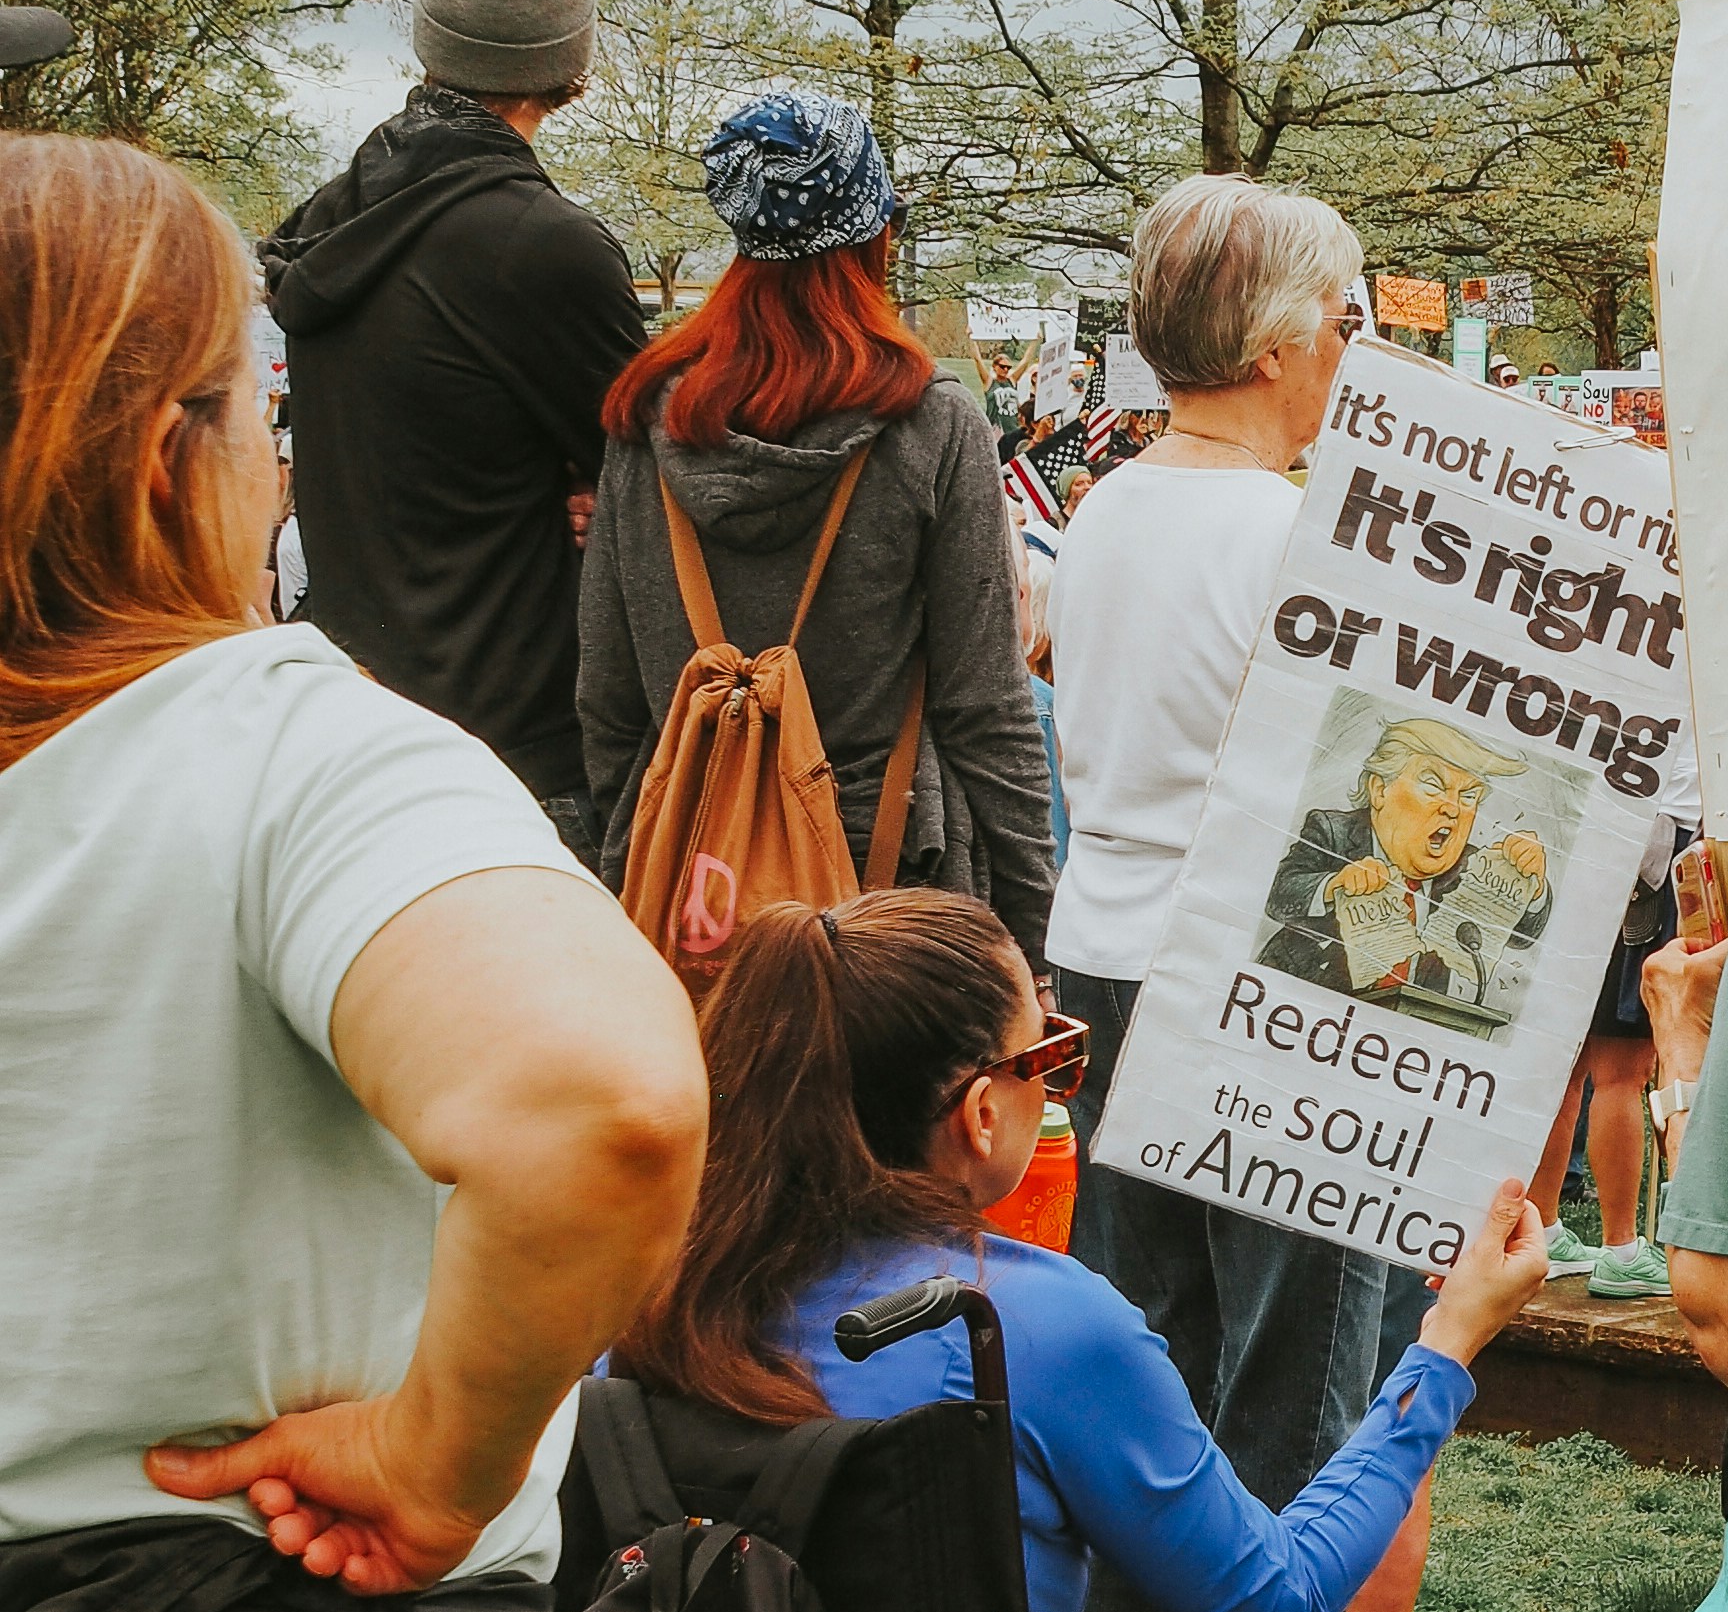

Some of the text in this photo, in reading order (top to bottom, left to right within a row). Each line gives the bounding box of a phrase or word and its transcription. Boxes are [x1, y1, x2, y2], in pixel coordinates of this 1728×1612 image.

[1330, 384, 1397, 448] It's
[1402, 421, 1492, 482] not
[1493, 447, 1577, 521] left
[1580, 495, 1636, 539] or
[1583, 378, 1609, 403] Say
[1584, 404, 1604, 417] NO
[1330, 466, 1684, 669] It's right
[1273, 593, 1680, 799] or wrong
[1470, 855, 1523, 901] People
[1218, 970, 1497, 1117] Redeem
[1140, 1125, 1465, 1270] of America
[1214, 1083, 1434, 1180] the soul
